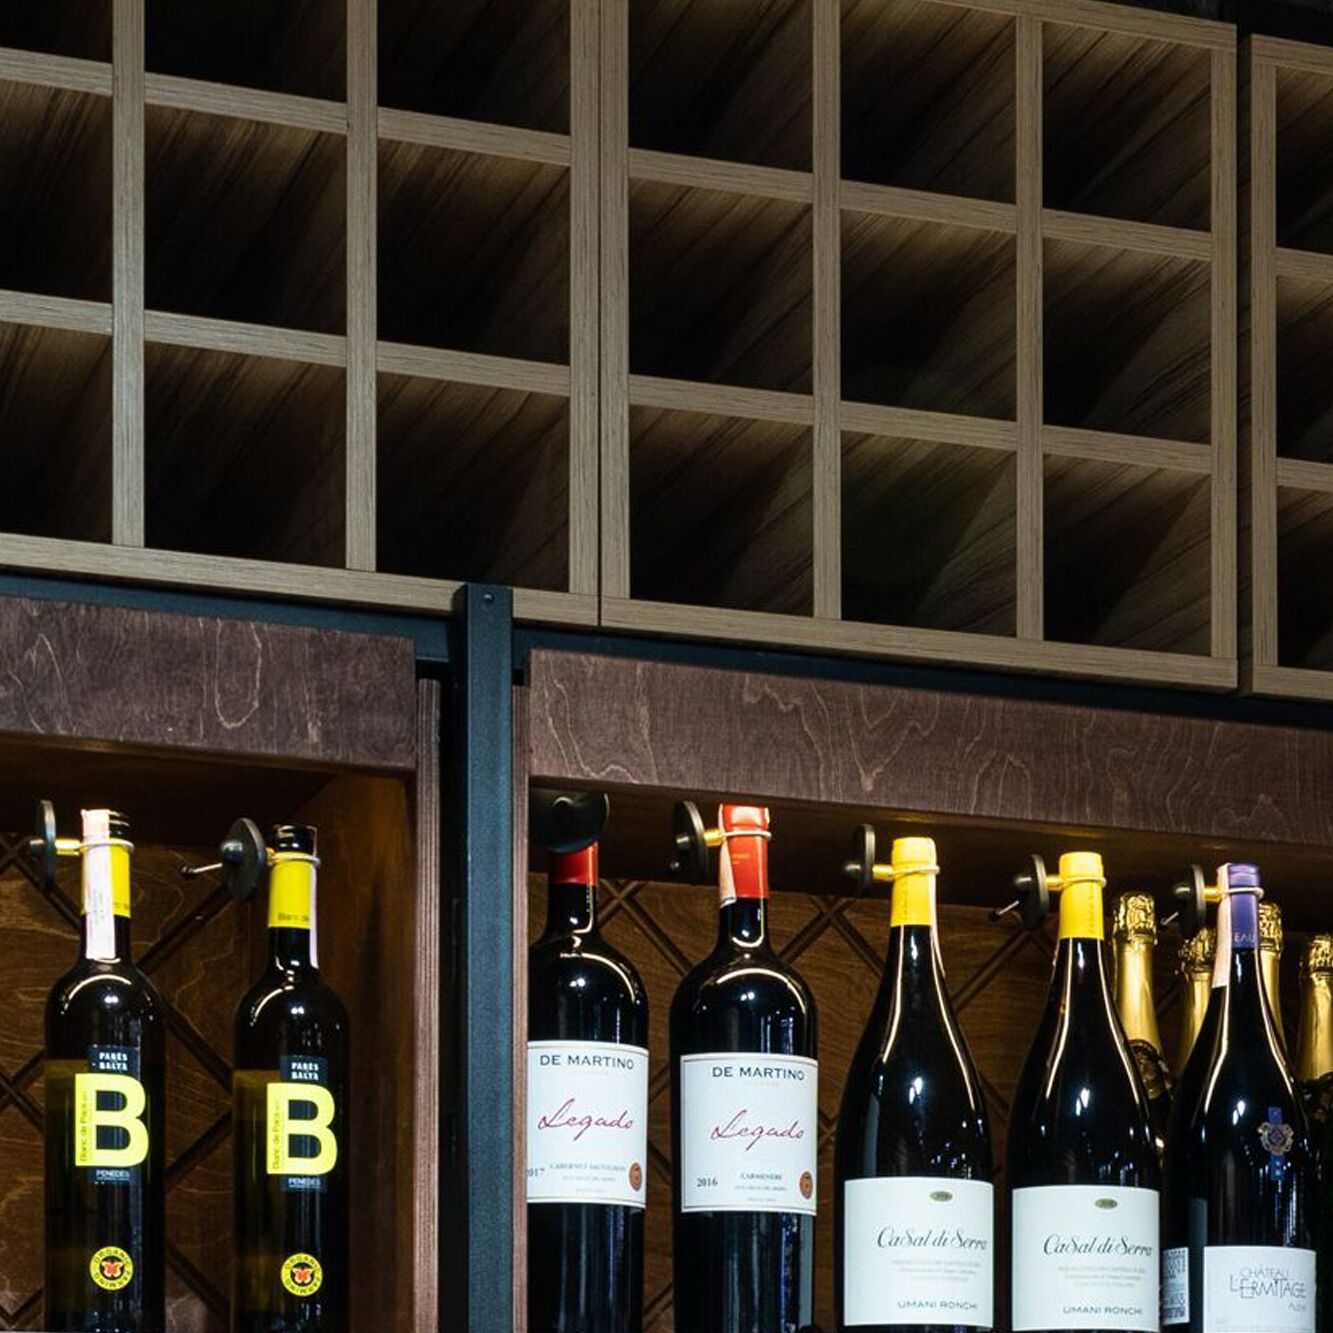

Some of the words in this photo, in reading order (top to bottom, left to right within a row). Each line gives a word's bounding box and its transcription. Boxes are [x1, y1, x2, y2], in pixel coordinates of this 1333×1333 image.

[540, 1055, 561, 1066] DE
[568, 1055, 634, 1070] MARTINO
[712, 1067, 733, 1077] DE
[740, 1067, 804, 1081] MARTINO
[75, 1073, 149, 1167] B
[267, 1083, 337, 1174] B
[537, 1098, 633, 1141] Legado
[710, 1109, 804, 1151] Legado
[697, 1178, 718, 1187] 2016
